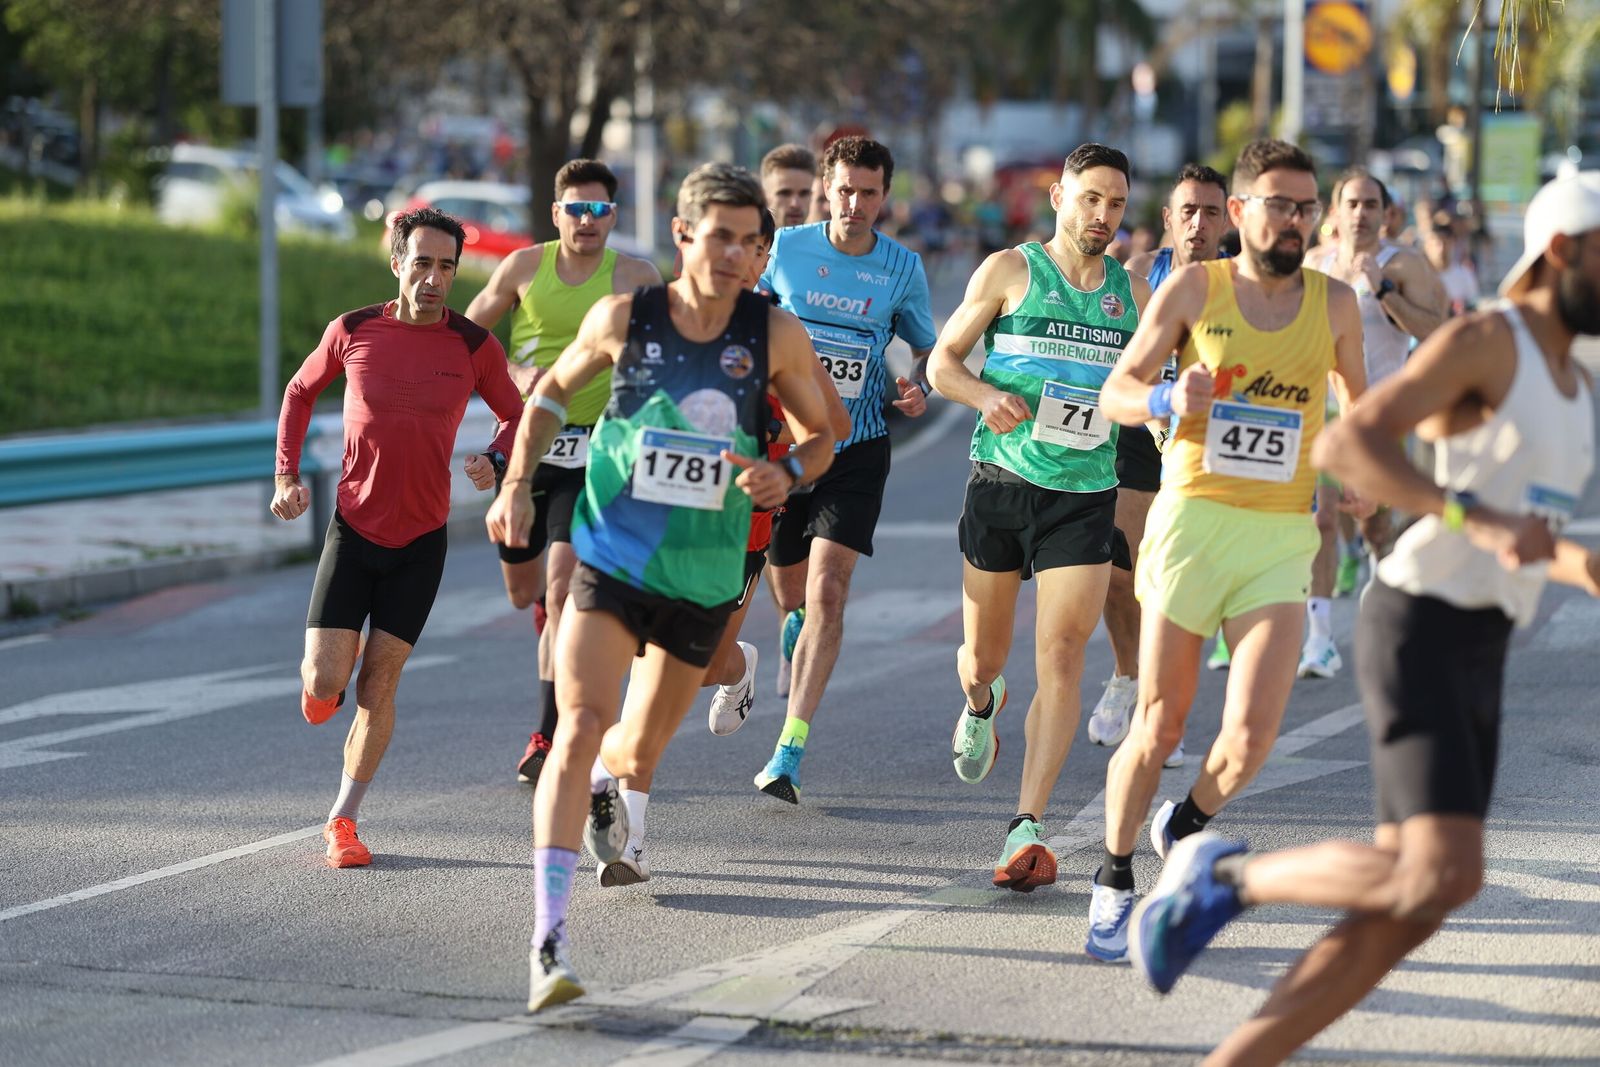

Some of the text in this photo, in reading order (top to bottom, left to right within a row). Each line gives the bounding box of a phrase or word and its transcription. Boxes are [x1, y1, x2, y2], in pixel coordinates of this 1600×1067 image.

[805, 290, 873, 315] woon!
[1046, 321, 1122, 345] ATLETISMO
[1243, 370, 1311, 403] Álora
[1063, 403, 1094, 430] 71
[544, 437, 579, 457] 27
[1221, 425, 1285, 457] 475
[645, 450, 722, 485] 1781
